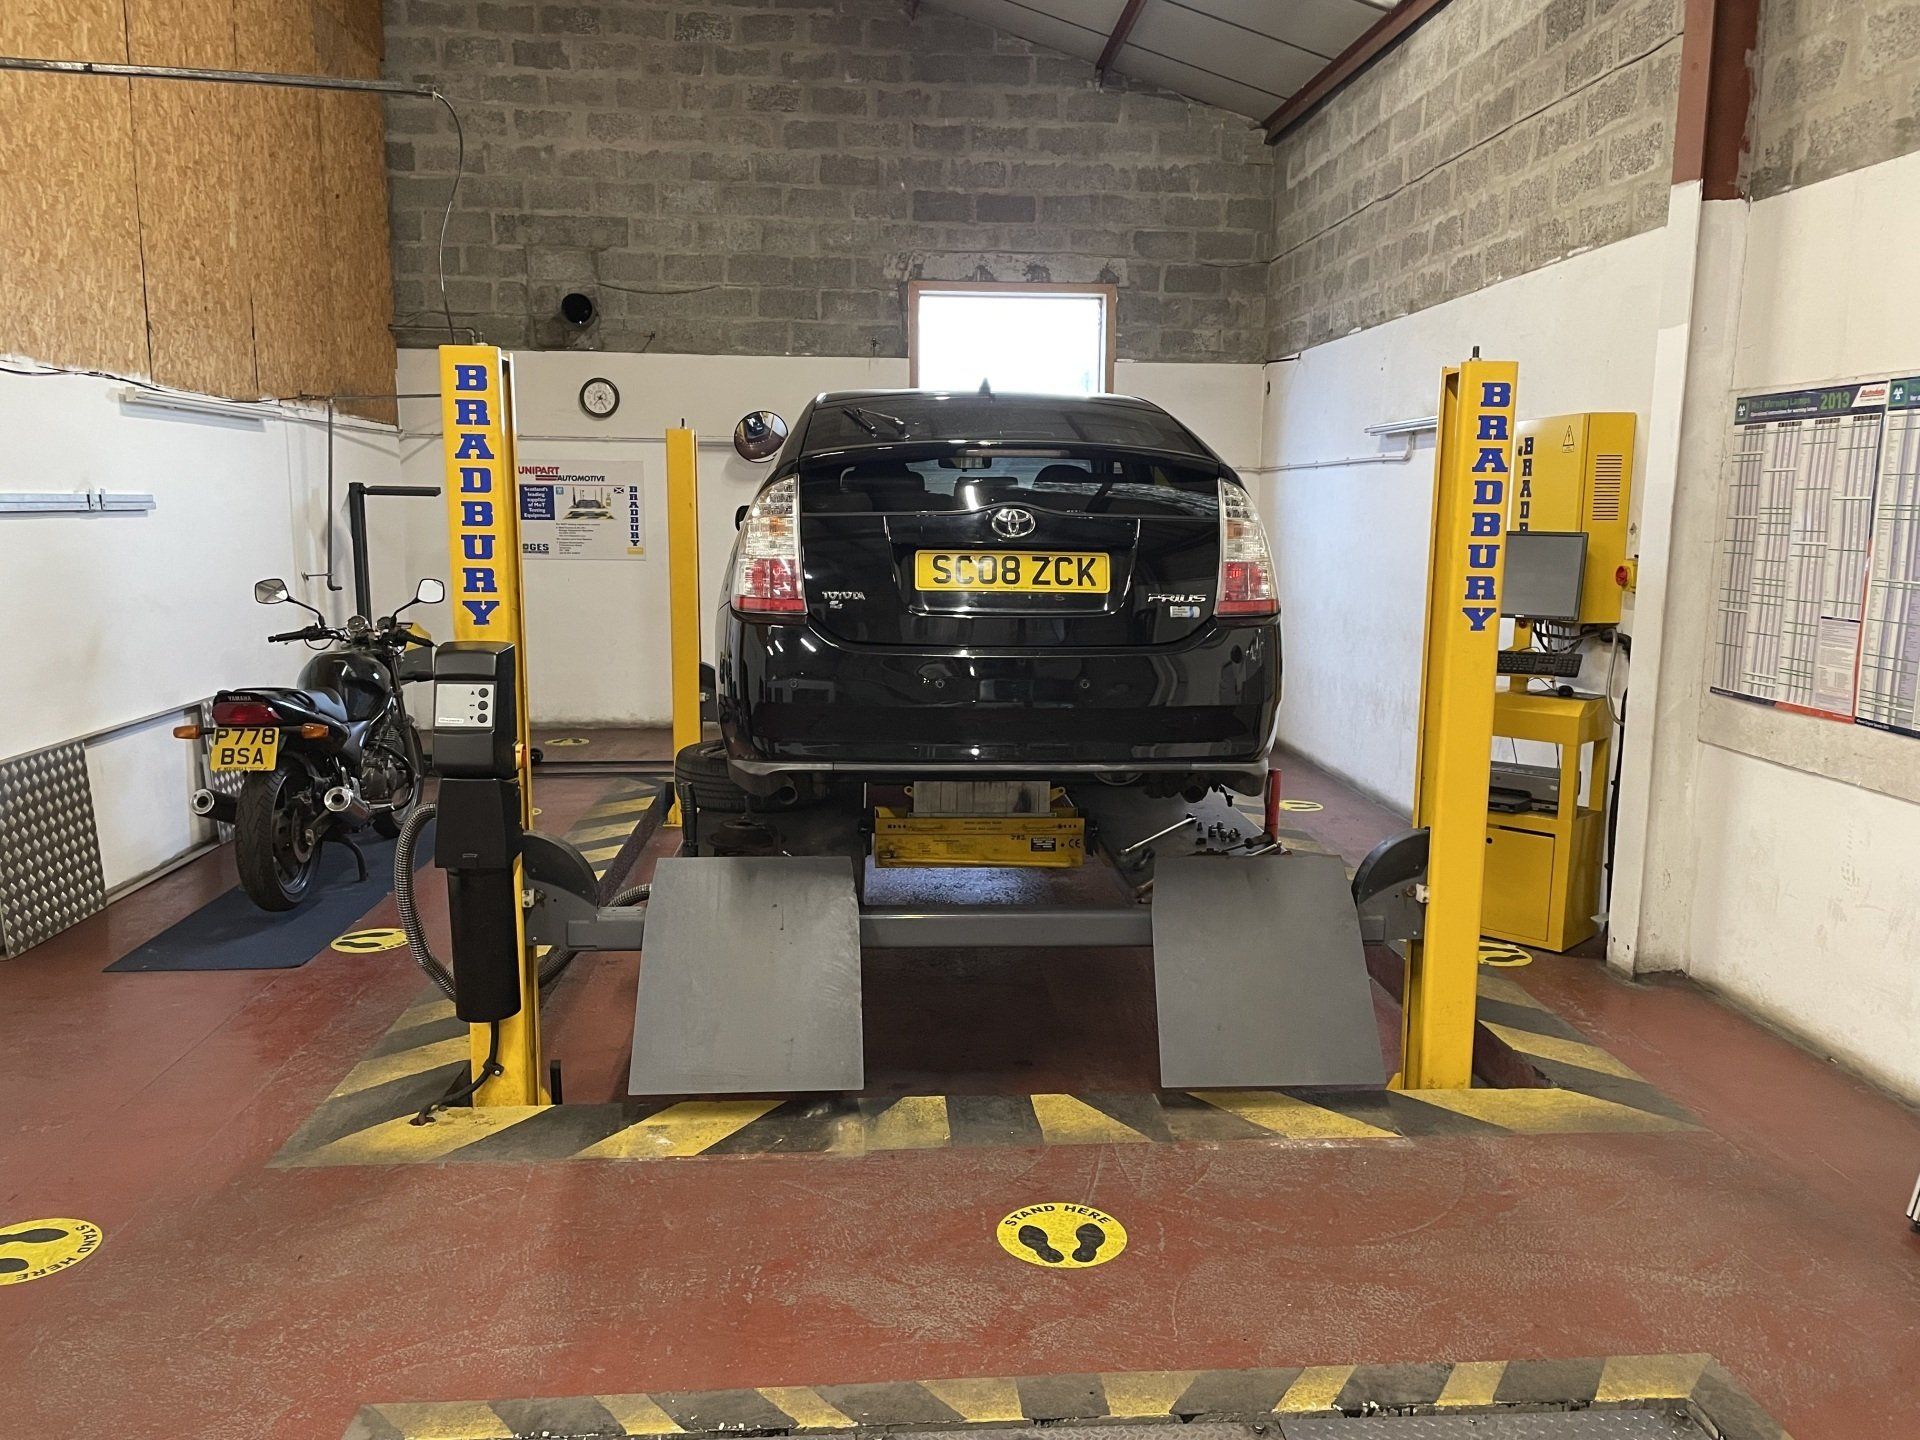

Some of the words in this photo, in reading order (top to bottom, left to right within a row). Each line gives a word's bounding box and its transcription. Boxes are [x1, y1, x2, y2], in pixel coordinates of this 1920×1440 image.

[1820, 390, 1850, 410] 2013
[518, 466, 560, 475] UNIPART
[454, 364, 500, 625] BRADBURY
[1519, 437, 1534, 531] BRADB
[1462, 382, 1511, 631] BRADBURY
[932, 555, 1021, 584] SC08
[1031, 556, 1097, 586] ZCK
[822, 591, 866, 600] TOYOTA
[1148, 593, 1207, 602] PRIUS
[215, 728, 275, 745] P778
[221, 748, 264, 765] BSA
[1005, 1204, 1055, 1226] STAND
[1064, 1204, 1111, 1224] HERE
[75, 1224, 98, 1253] STAND
[15, 1257, 78, 1281] HERE
